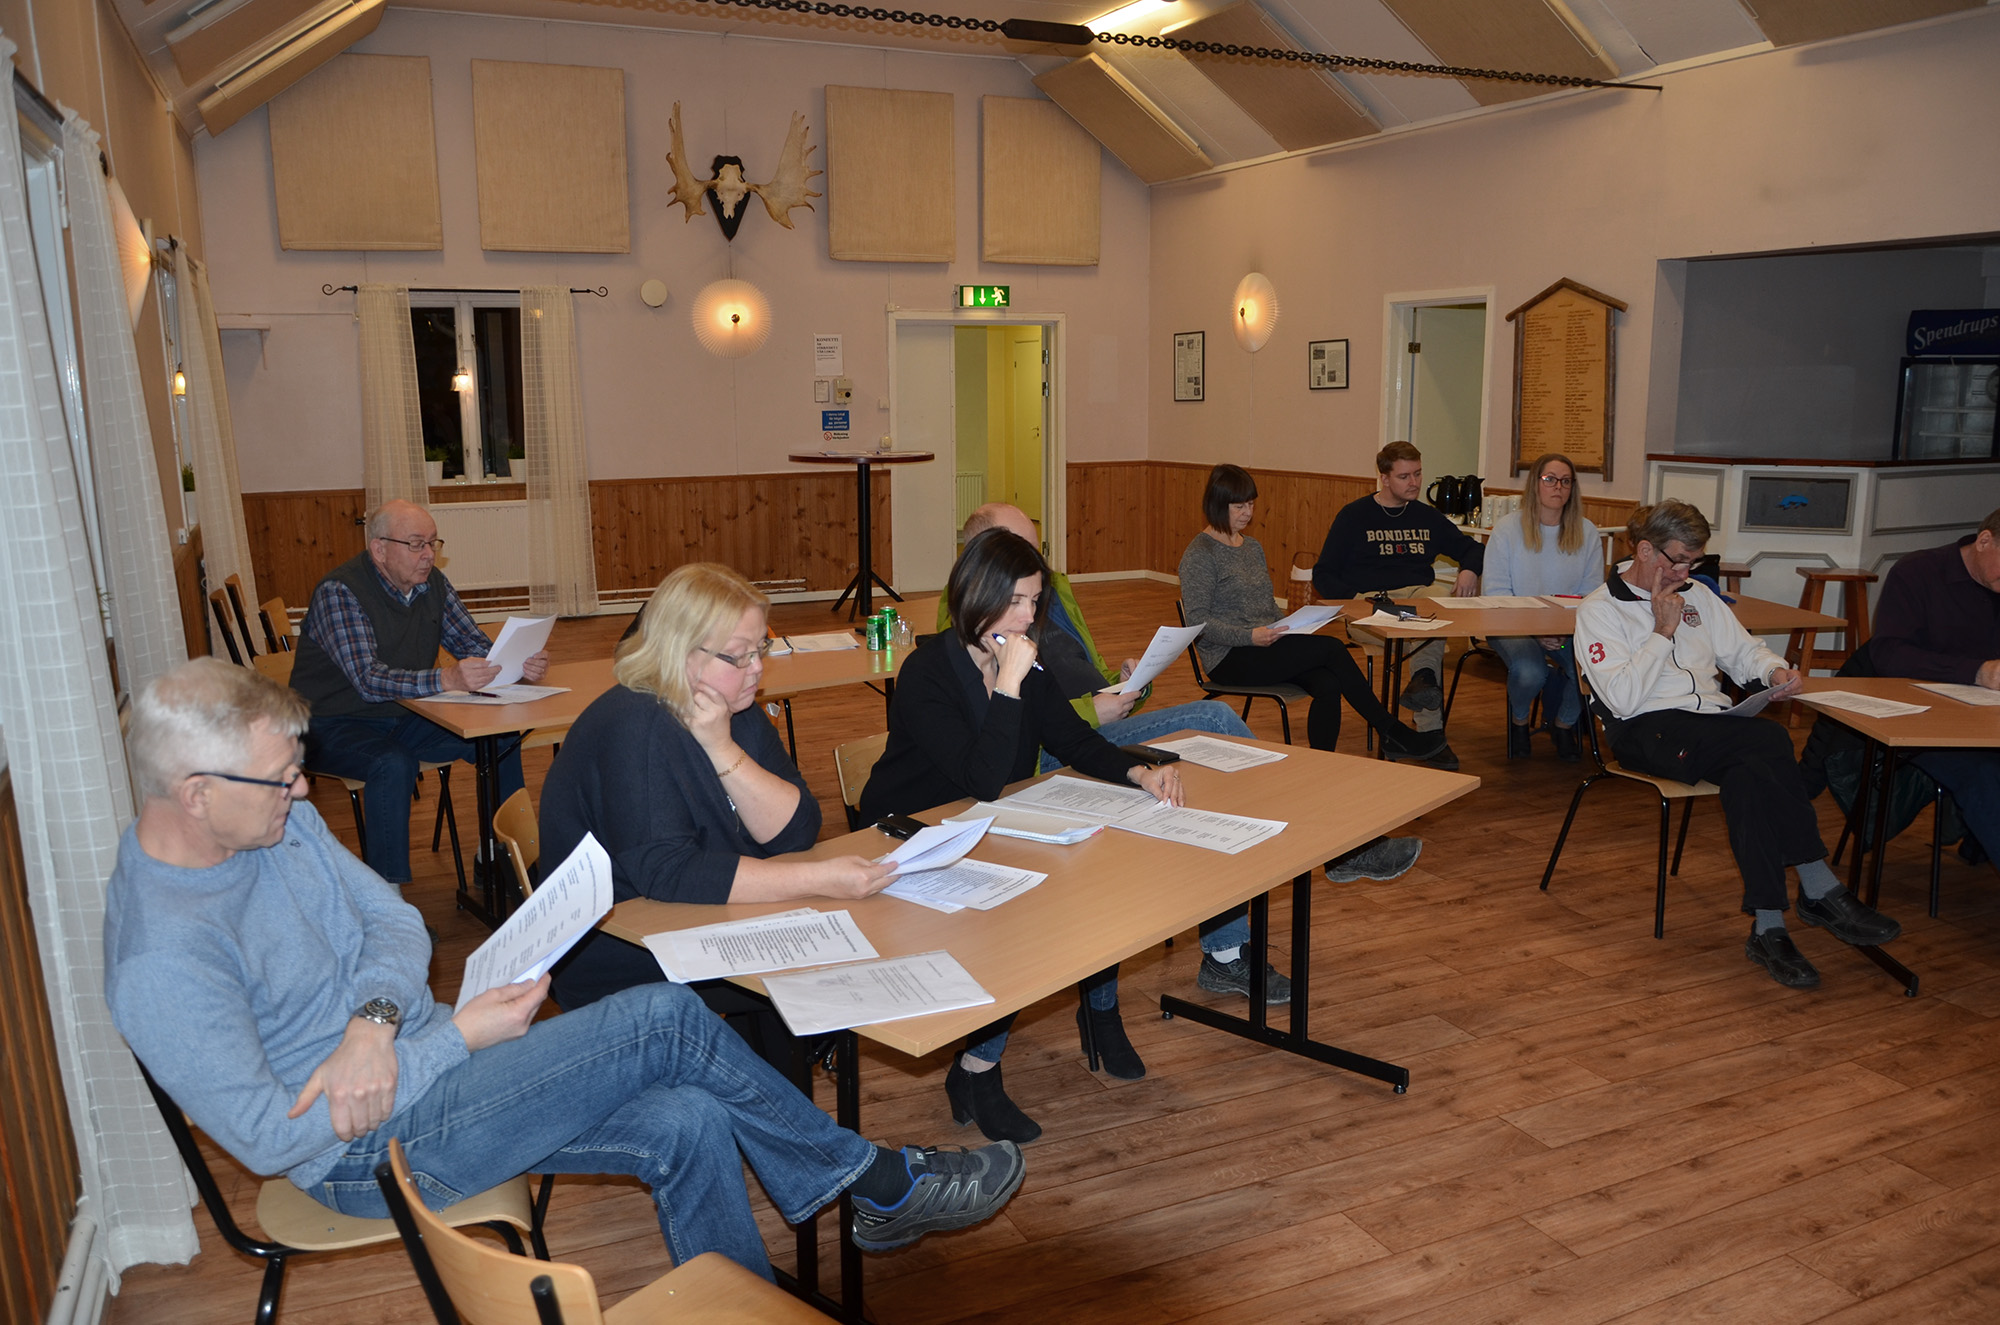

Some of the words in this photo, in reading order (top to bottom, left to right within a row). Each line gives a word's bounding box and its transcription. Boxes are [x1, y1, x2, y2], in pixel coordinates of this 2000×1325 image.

[1914, 315, 1999, 350] Spendrups
[1366, 529, 1430, 542] BONDELID
[1379, 543, 1394, 555] 19
[1409, 543, 1425, 555] 56
[1588, 642, 1606, 664] 3
